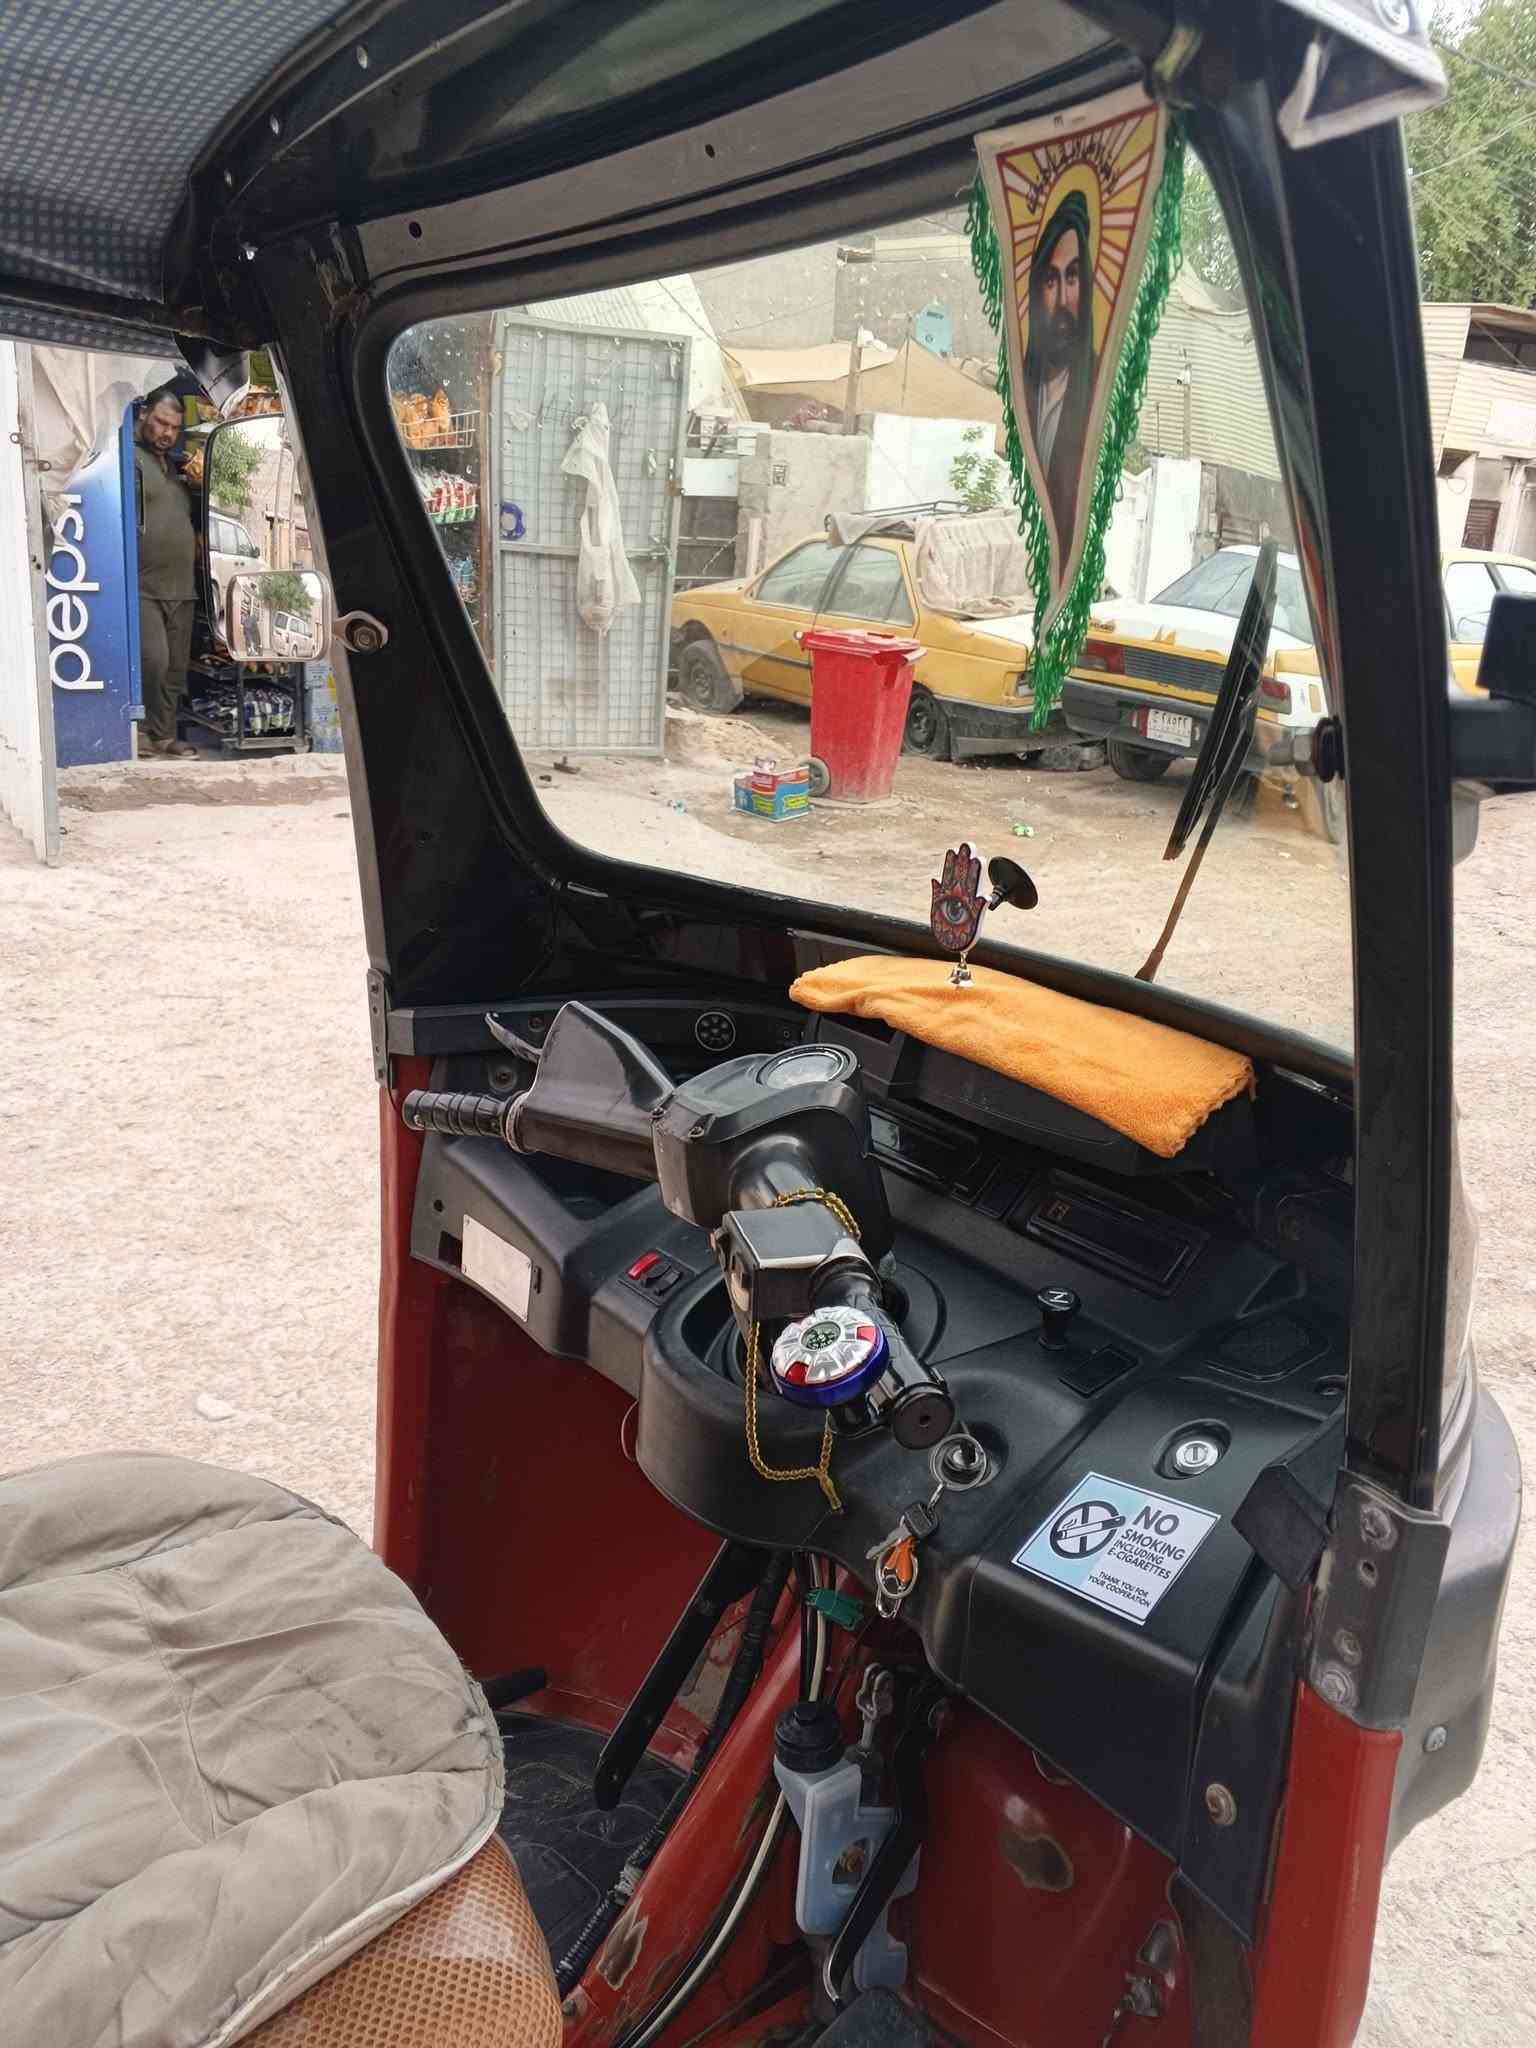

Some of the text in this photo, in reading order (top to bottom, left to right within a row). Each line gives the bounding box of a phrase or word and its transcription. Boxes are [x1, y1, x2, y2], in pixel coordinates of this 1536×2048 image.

[1132, 1505, 1180, 1536] NO
[1113, 1540, 1165, 1565] INCLUDING
[1121, 1528, 1186, 1561] SMOKING
[1107, 1547, 1172, 1580] E-CIGARETTES
[1088, 1575, 1152, 1608] YOUR COOPERATION
[1099, 1571, 1149, 1599] THANK YOU FOR
